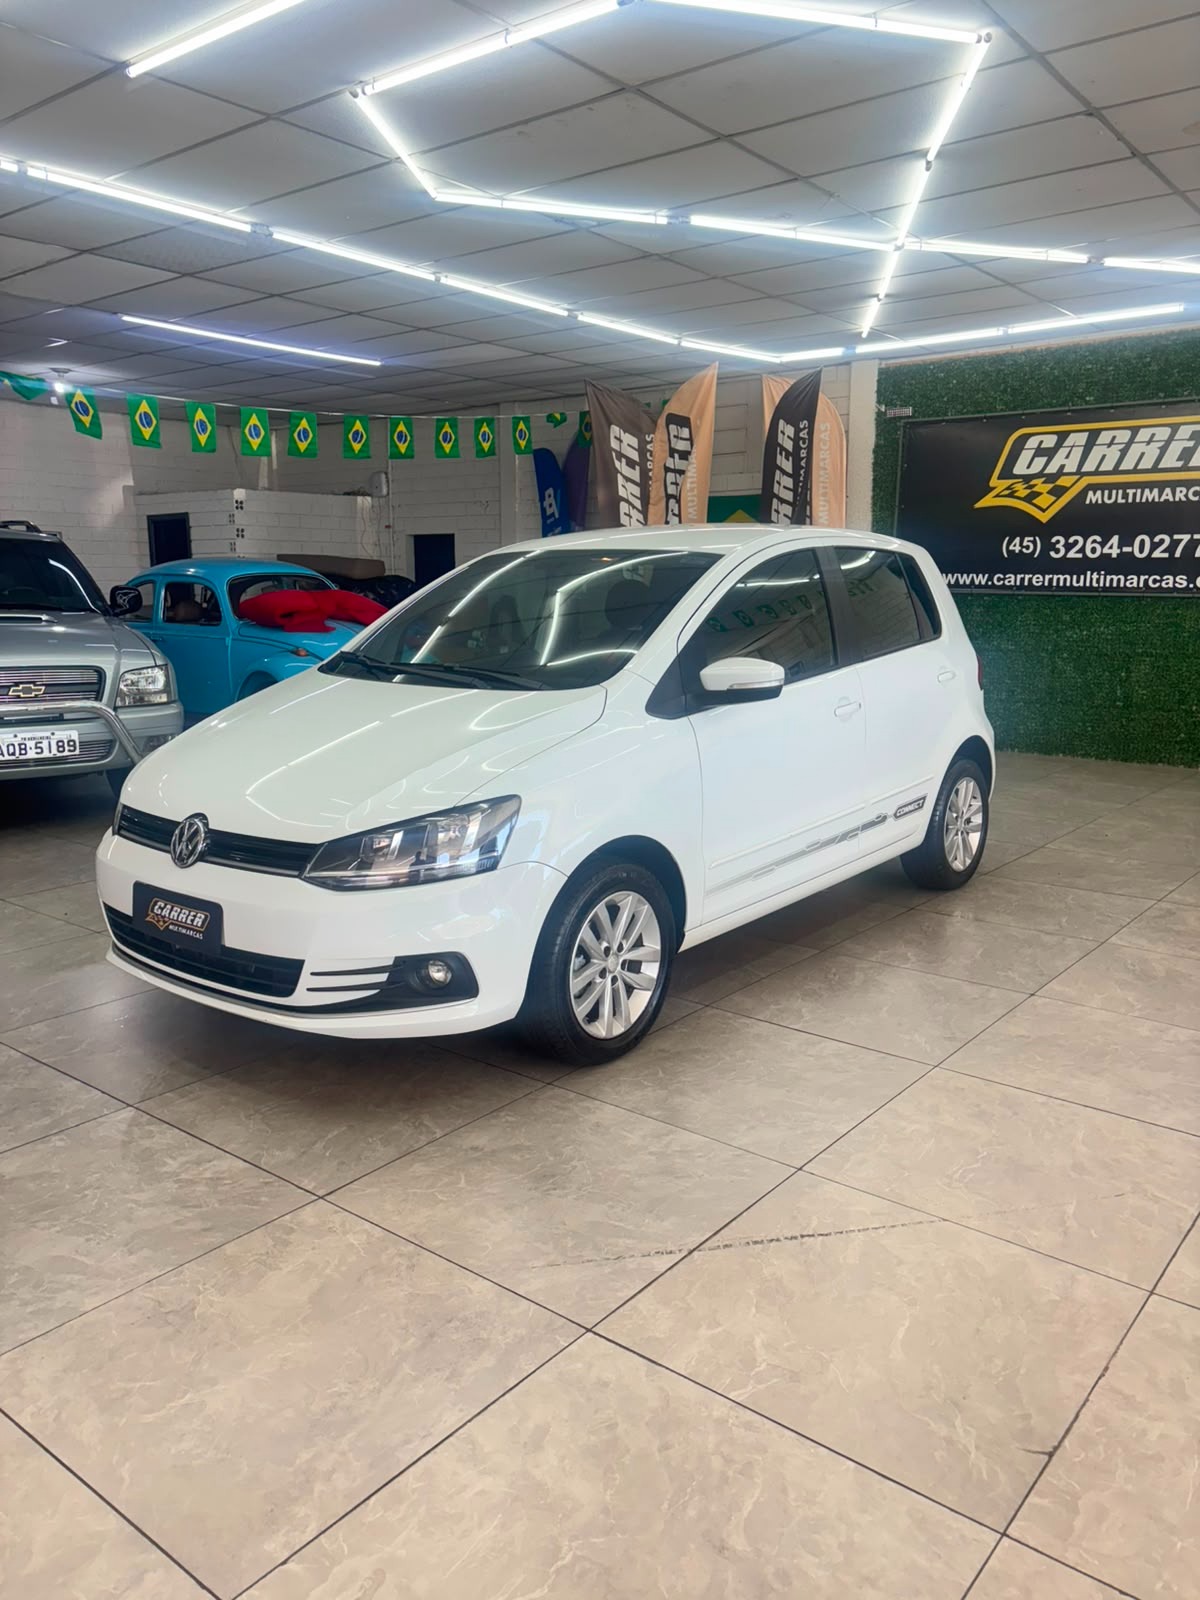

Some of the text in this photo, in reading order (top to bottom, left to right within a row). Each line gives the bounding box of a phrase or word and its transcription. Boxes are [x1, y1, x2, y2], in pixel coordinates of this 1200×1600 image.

[1002, 536, 1041, 558] (45)
[153, 901, 205, 927] CARRER
[168, 924, 203, 940] MULTIMARCAS
